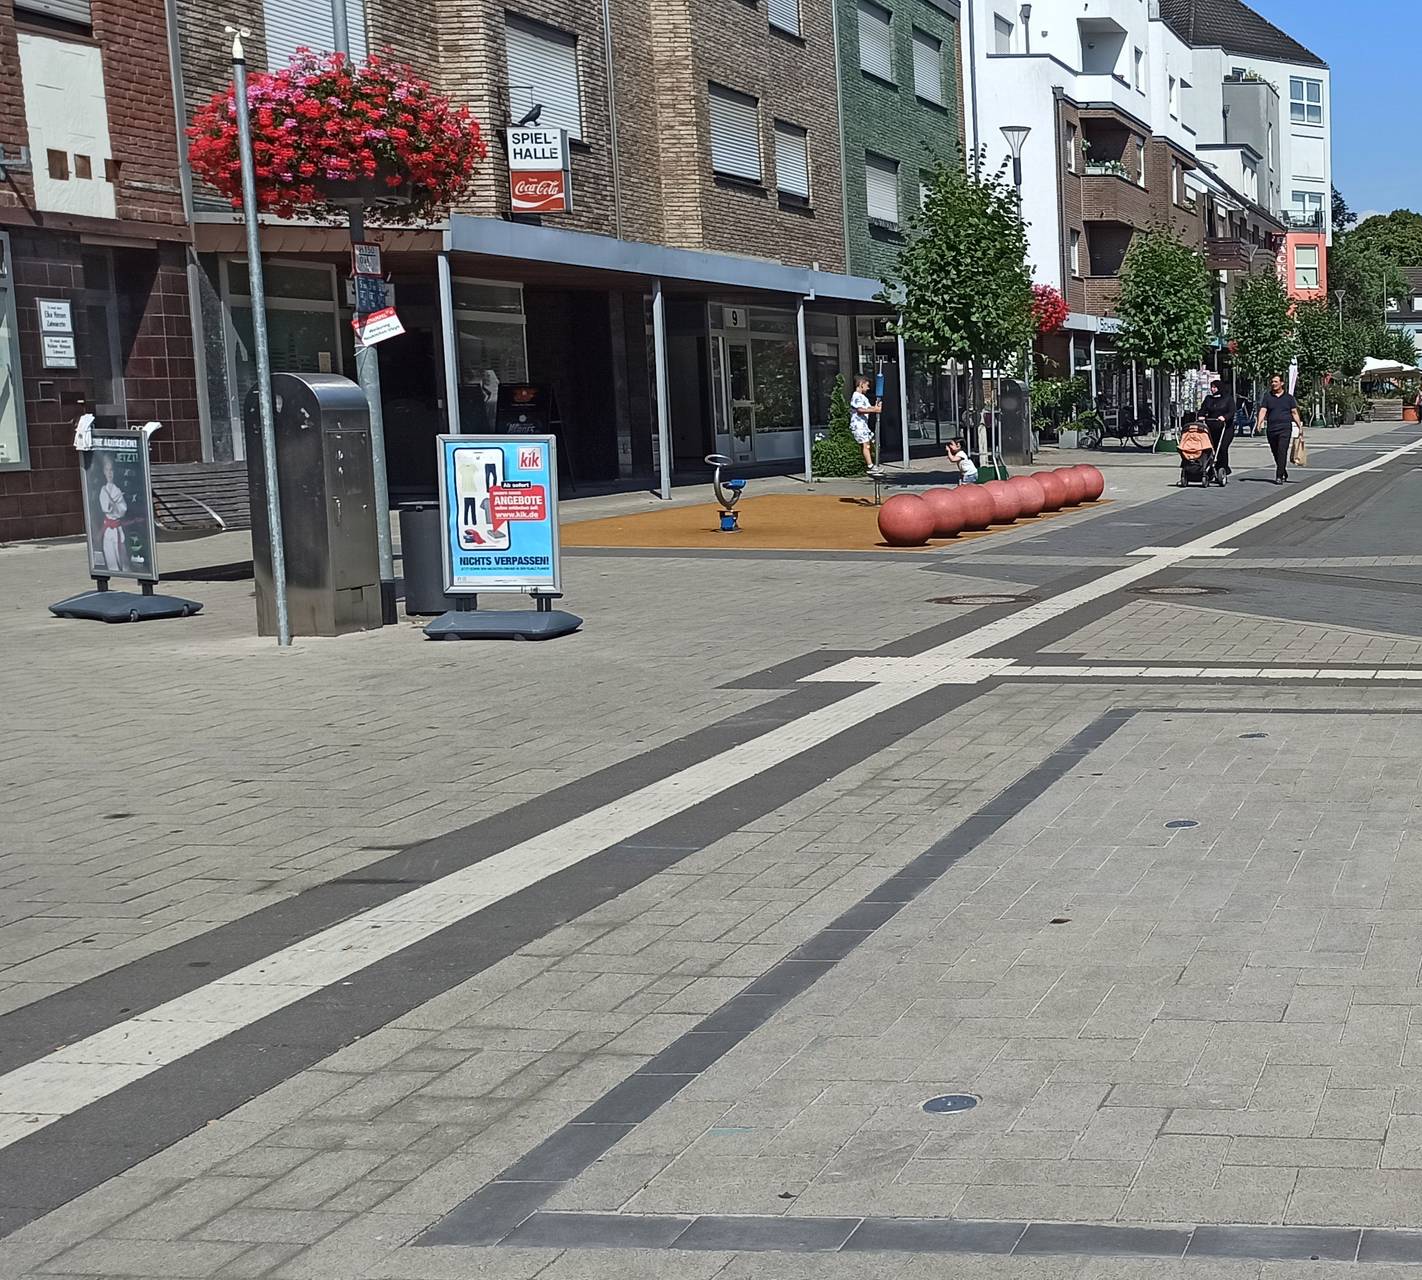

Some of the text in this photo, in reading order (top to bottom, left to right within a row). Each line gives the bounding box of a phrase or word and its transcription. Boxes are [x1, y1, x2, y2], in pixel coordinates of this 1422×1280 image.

[511, 133, 558, 144] SPIEL-
[513, 148, 559, 159] HALLE
[732, 310, 738, 326] 9
[520, 450, 540, 468] kik
[494, 496, 543, 505] ANGEBOTE
[459, 556, 549, 566] NICHTS VERPASSEN!
